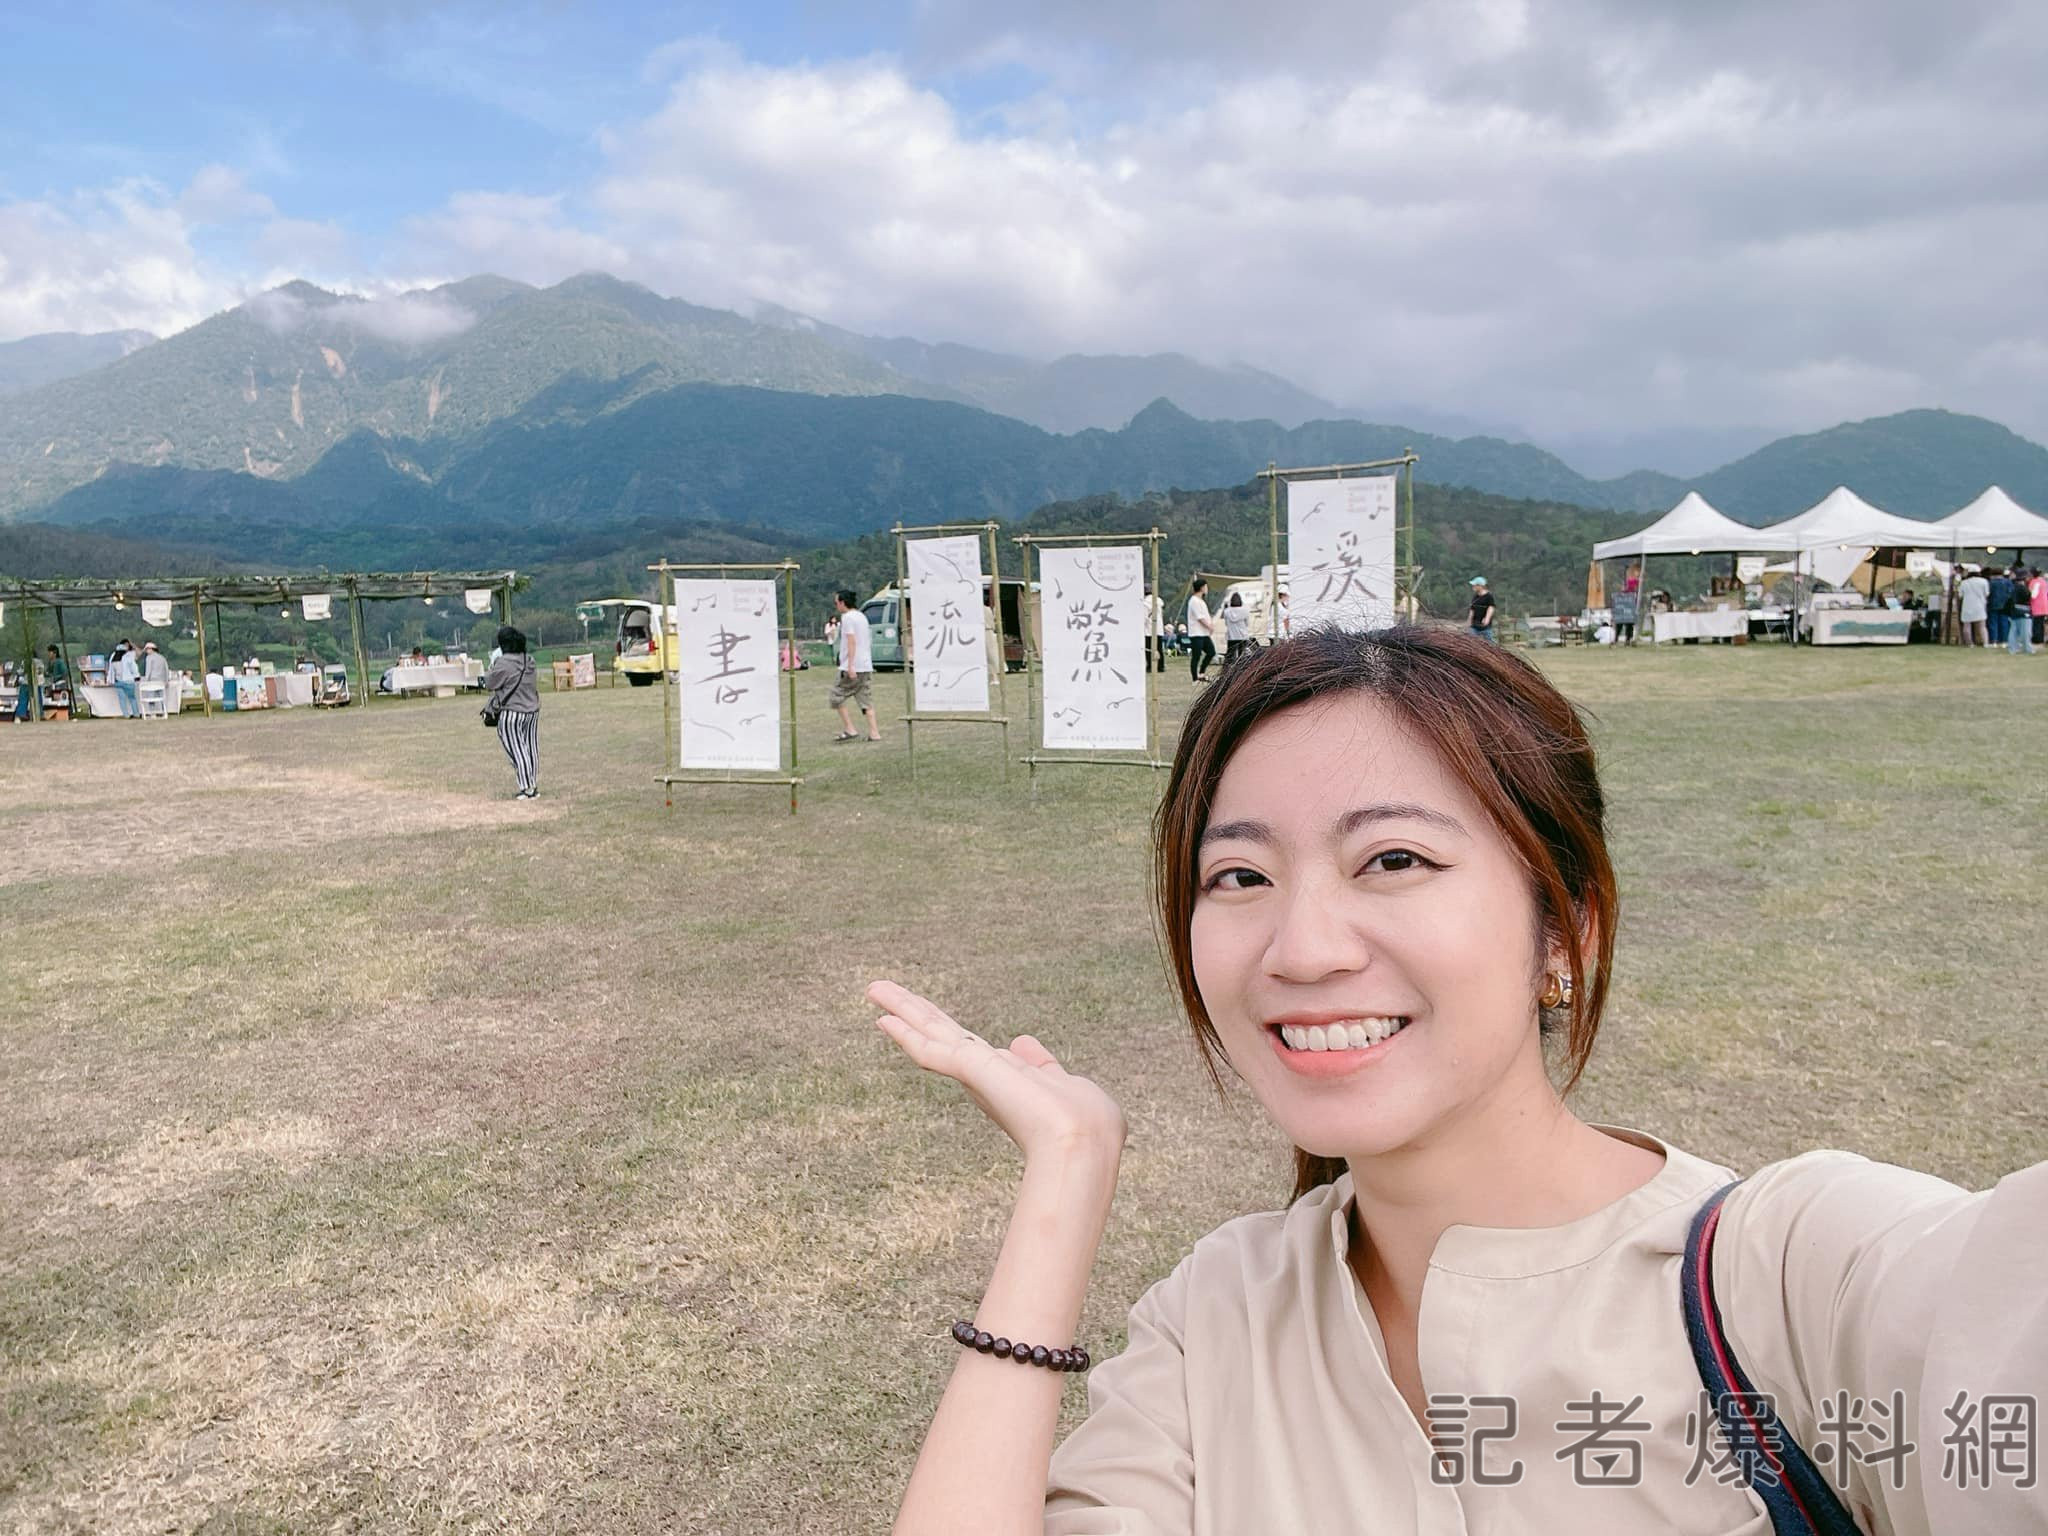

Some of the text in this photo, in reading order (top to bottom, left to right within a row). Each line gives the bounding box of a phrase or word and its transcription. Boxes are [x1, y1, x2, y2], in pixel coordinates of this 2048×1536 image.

[1311, 530, 1378, 603] 溪
[694, 623, 755, 704] 書
[924, 599, 977, 659] 流
